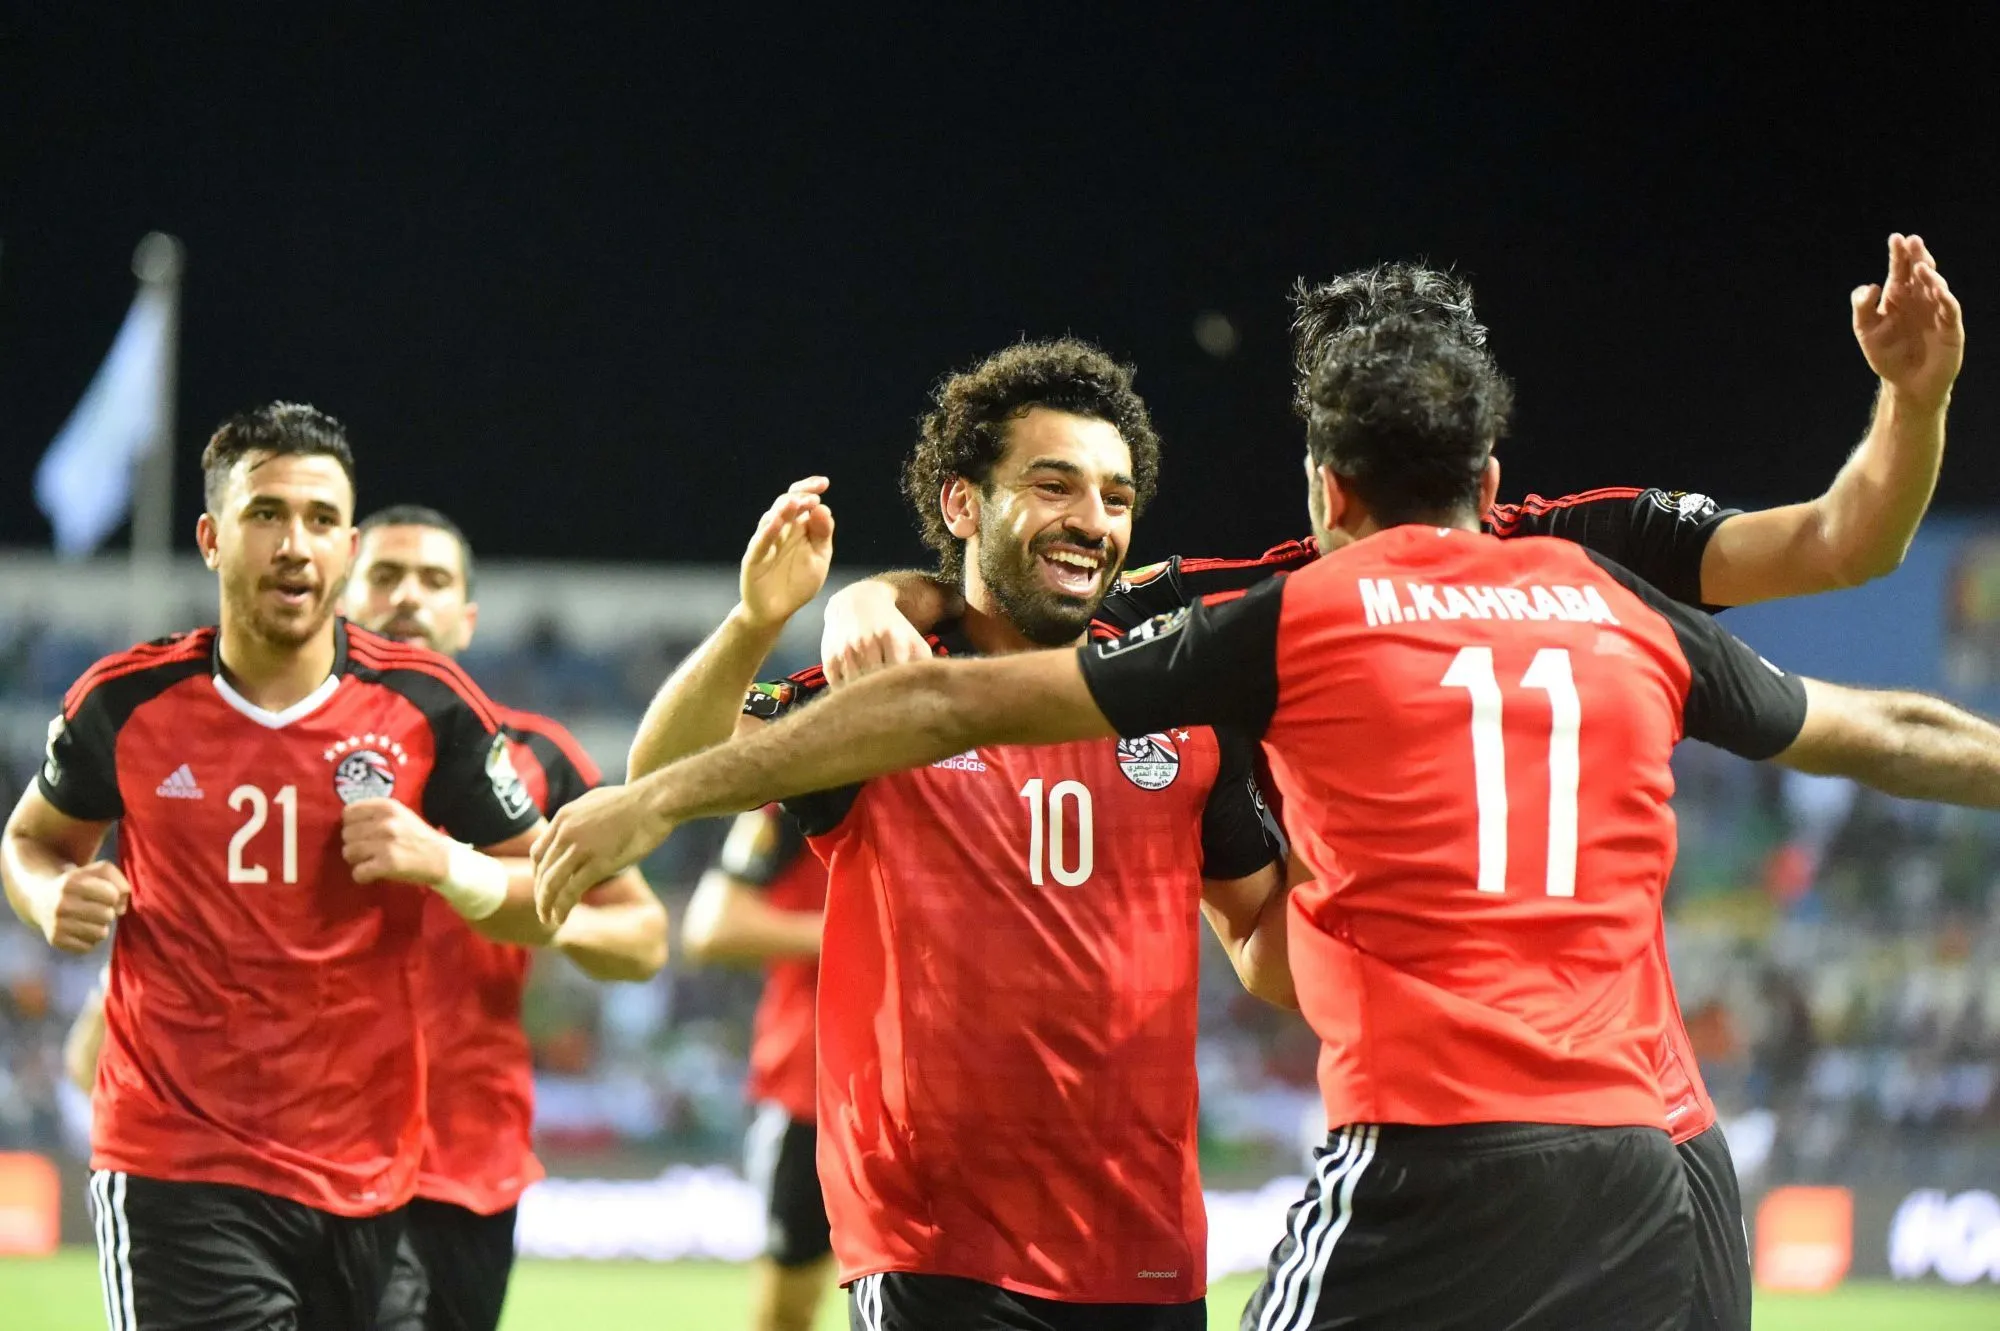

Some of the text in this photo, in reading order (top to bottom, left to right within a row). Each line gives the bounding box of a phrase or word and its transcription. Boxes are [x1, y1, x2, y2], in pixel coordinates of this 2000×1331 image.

[1358, 578, 1621, 627] M.KAHRABA
[155, 785, 205, 800] adidas
[1440, 646, 1582, 897] 11
[227, 785, 298, 883] 21
[1019, 778, 1094, 887] 10
[1137, 1269, 1178, 1279] climacool
